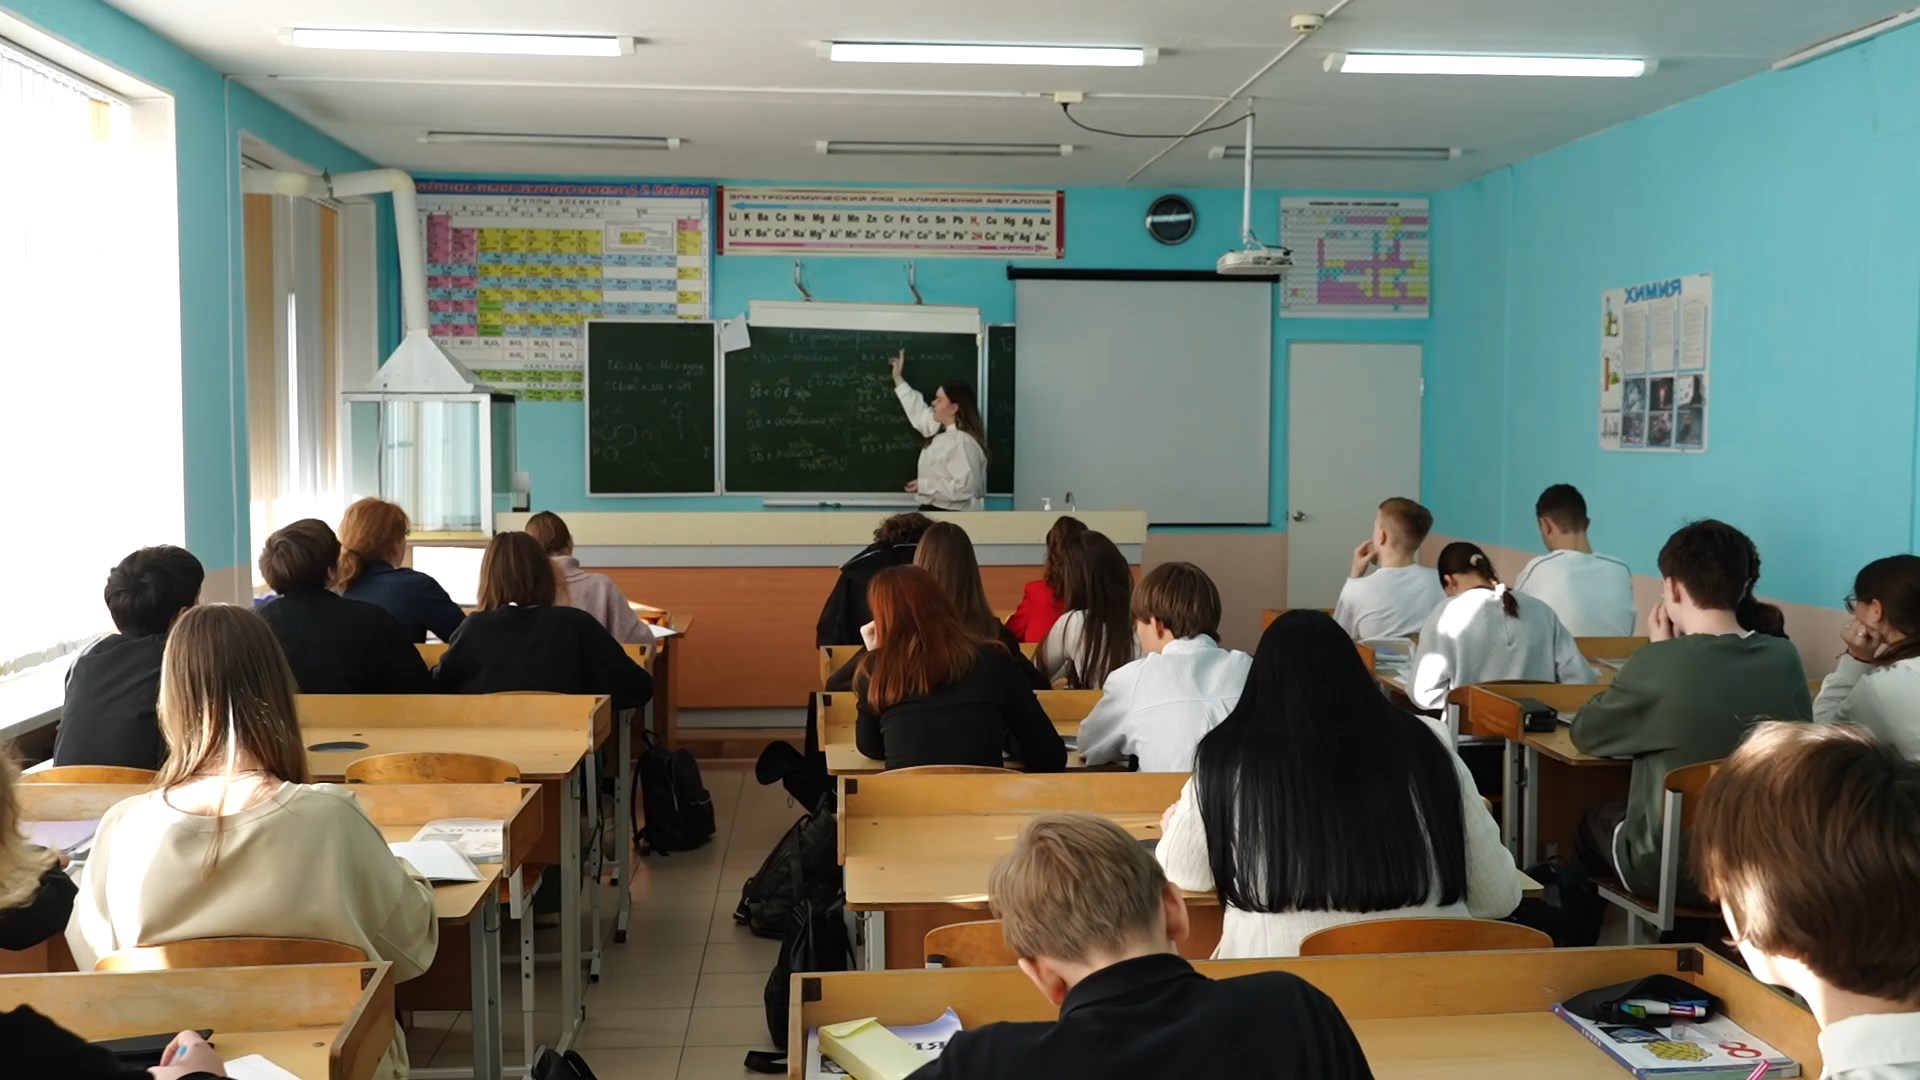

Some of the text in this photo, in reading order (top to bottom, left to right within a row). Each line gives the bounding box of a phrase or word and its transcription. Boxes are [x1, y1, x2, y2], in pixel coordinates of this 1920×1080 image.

[729, 212, 737, 221] Li
[744, 213, 750, 221] K
[758, 213, 768, 221] Ba
[776, 213, 787, 221] Ca
[794, 213, 805, 222] Na
[813, 214, 825, 224] Mg
[832, 214, 840, 222] Al
[848, 214, 860, 222] Mn
[867, 214, 877, 223] Zn
[884, 215, 894, 223] Cr
[901, 215, 910, 223] Fe
[917, 215, 928, 224] Co
[936, 216, 946, 224] Sn
[953, 216, 964, 224] Pb
[986, 216, 997, 225] Cu
[1004, 217, 1015, 227] Hg
[1022, 217, 1033, 227] Ag
[1040, 217, 1051, 225] Au
[1624, 278, 1681, 303] ХИМИЯ
